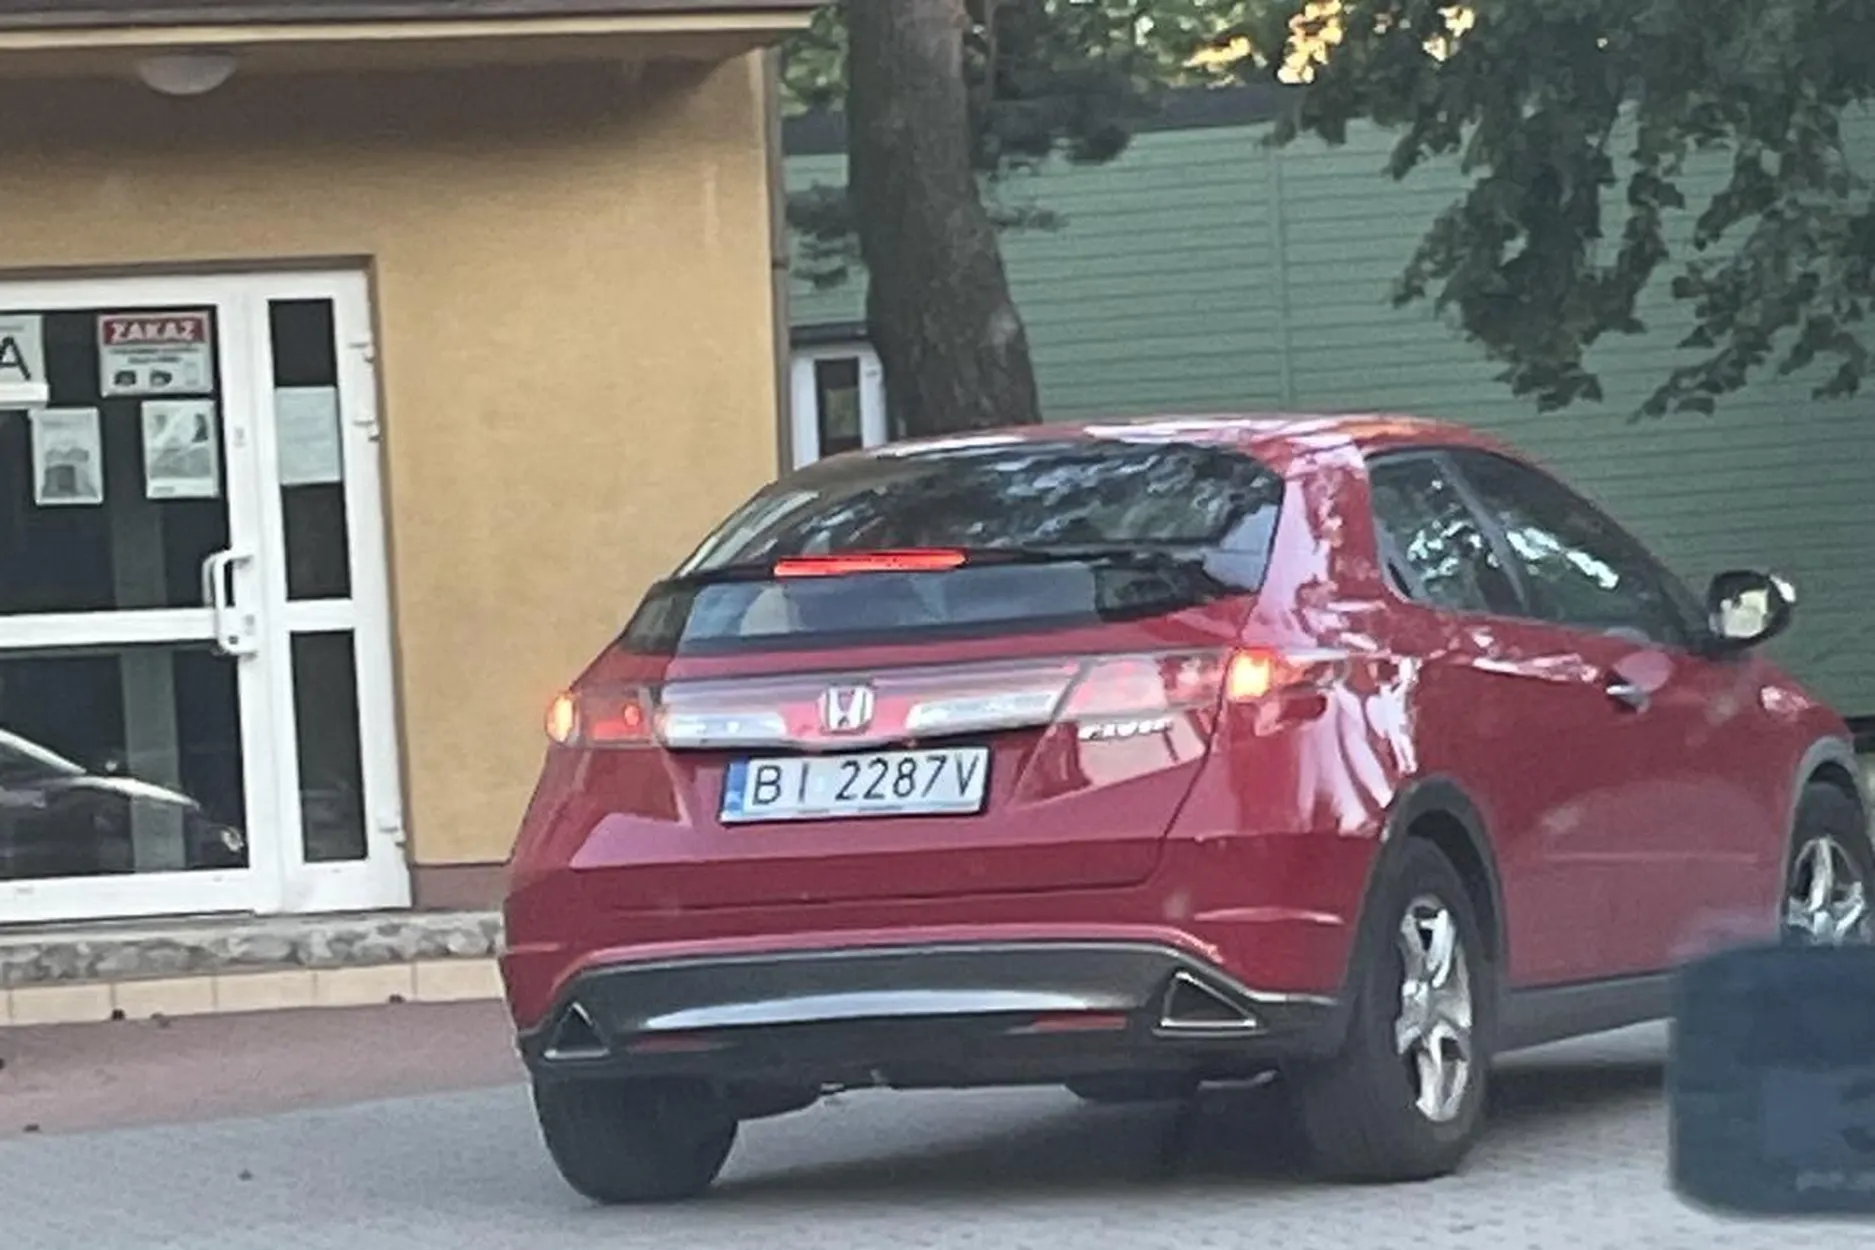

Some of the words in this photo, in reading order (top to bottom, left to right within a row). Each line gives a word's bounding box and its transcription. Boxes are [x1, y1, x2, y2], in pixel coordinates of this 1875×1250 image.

[110, 320, 195, 342] ZAKAZ
[752, 763, 809, 806] BI
[835, 755, 980, 800] 2287V
